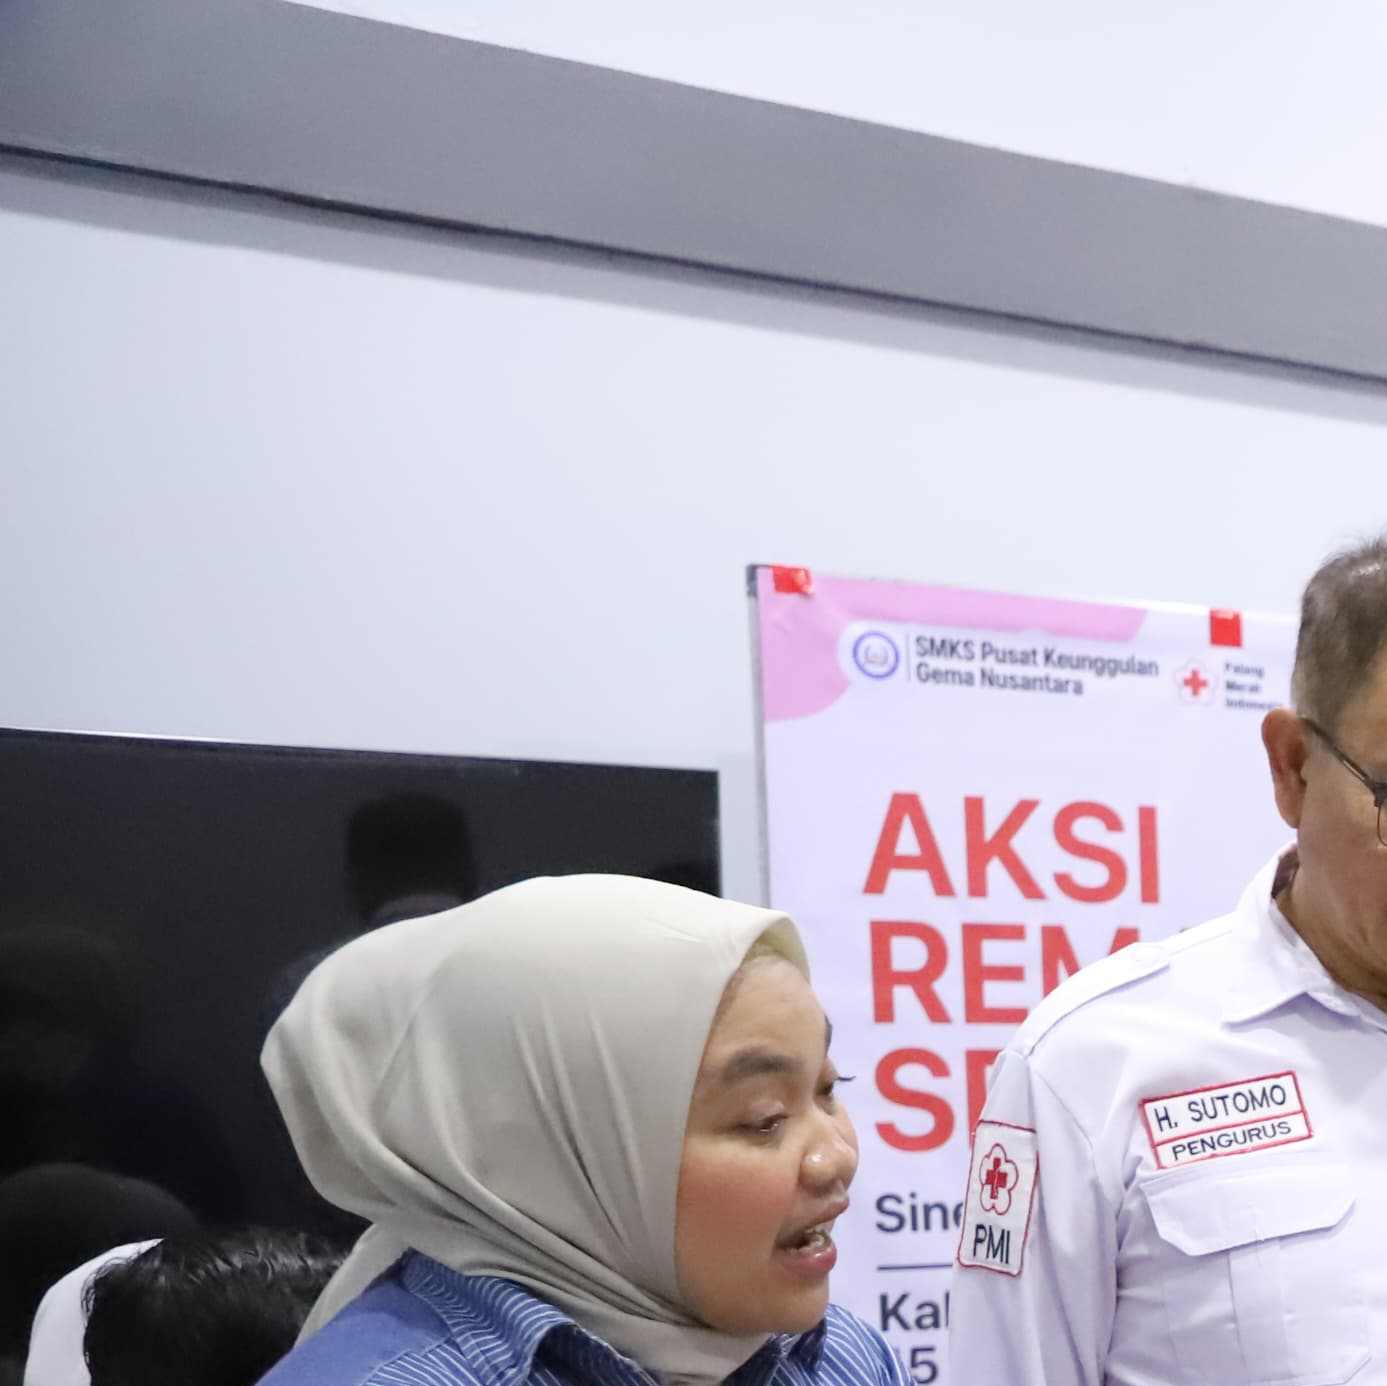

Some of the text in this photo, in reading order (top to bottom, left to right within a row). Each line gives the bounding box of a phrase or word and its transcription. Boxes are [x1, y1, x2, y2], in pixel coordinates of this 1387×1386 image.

[915, 635, 1159, 679] SMKS Pusat Keunggulan
[915, 661, 1084, 696] Gema Nusantara
[862, 791, 1160, 904] AKSI
[1154, 1083, 1287, 1133] H. SUTOMO
[1171, 1121, 1292, 1162] PENGURUS
[972, 1223, 1012, 1265] PMI
